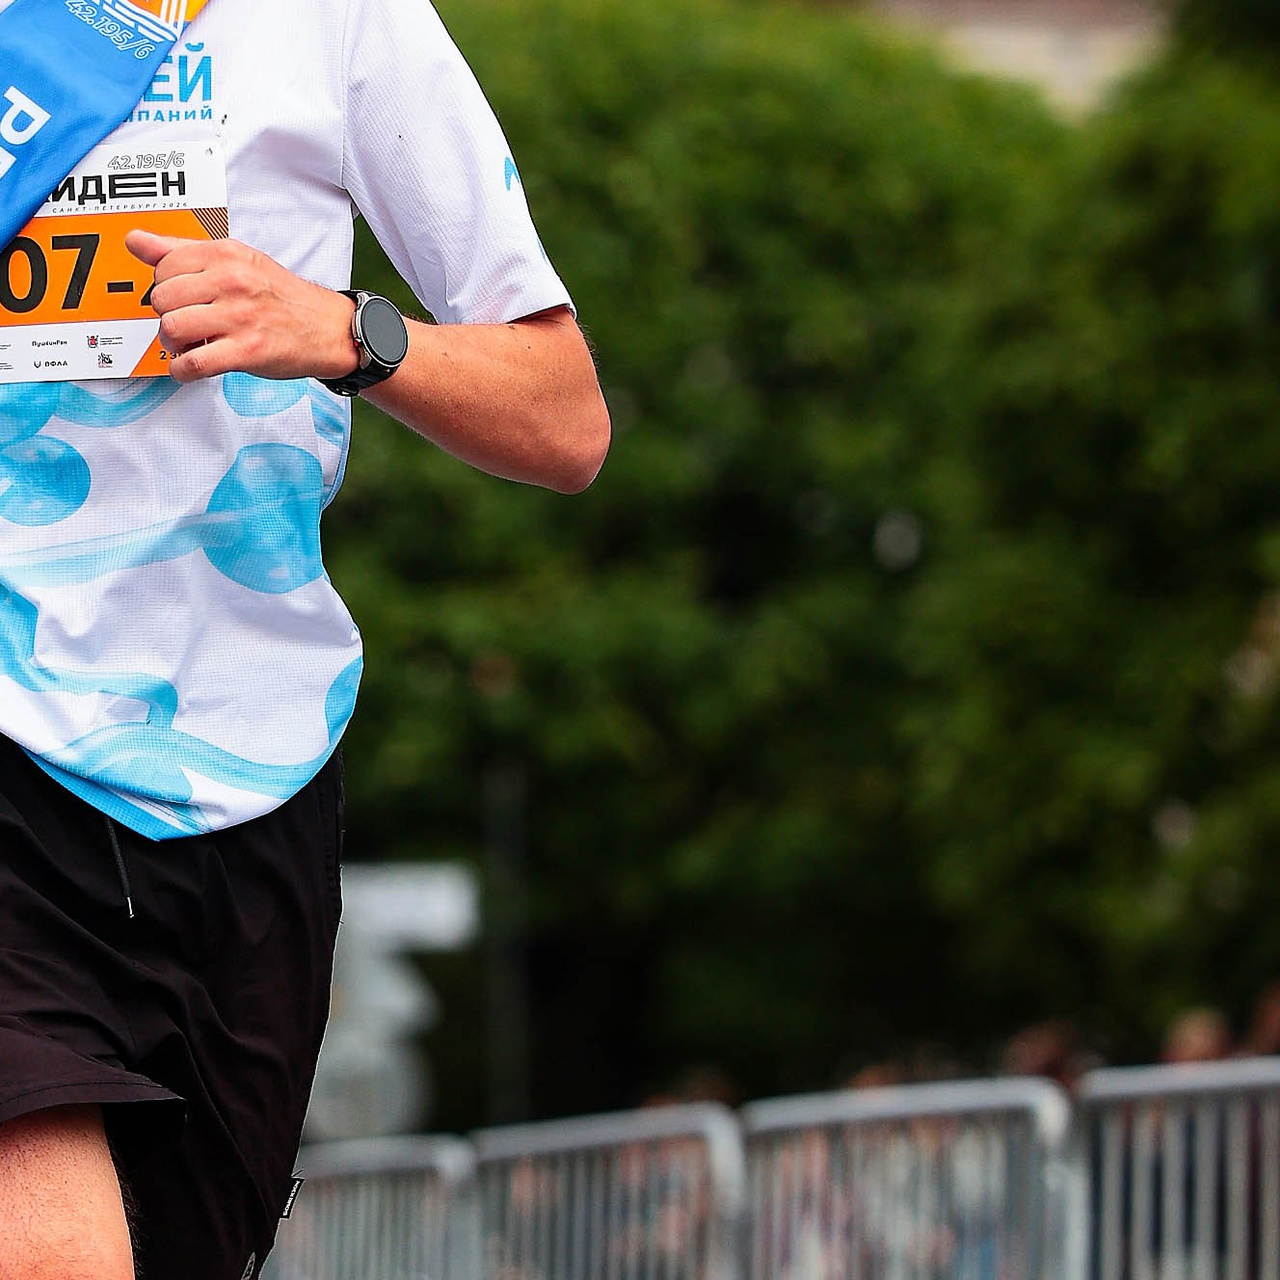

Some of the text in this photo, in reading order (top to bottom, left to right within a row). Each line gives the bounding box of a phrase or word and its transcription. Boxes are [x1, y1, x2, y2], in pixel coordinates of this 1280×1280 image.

[65, 0, 155, 59] 42.195/6
[126, 105, 212, 122] ПАНИЙ
[108, 151, 185, 170] 42.195/6
[45, 171, 186, 206] ИДЕН
[52, 203, 158, 213] САНКТ-ПЕТЕРБУРГ
